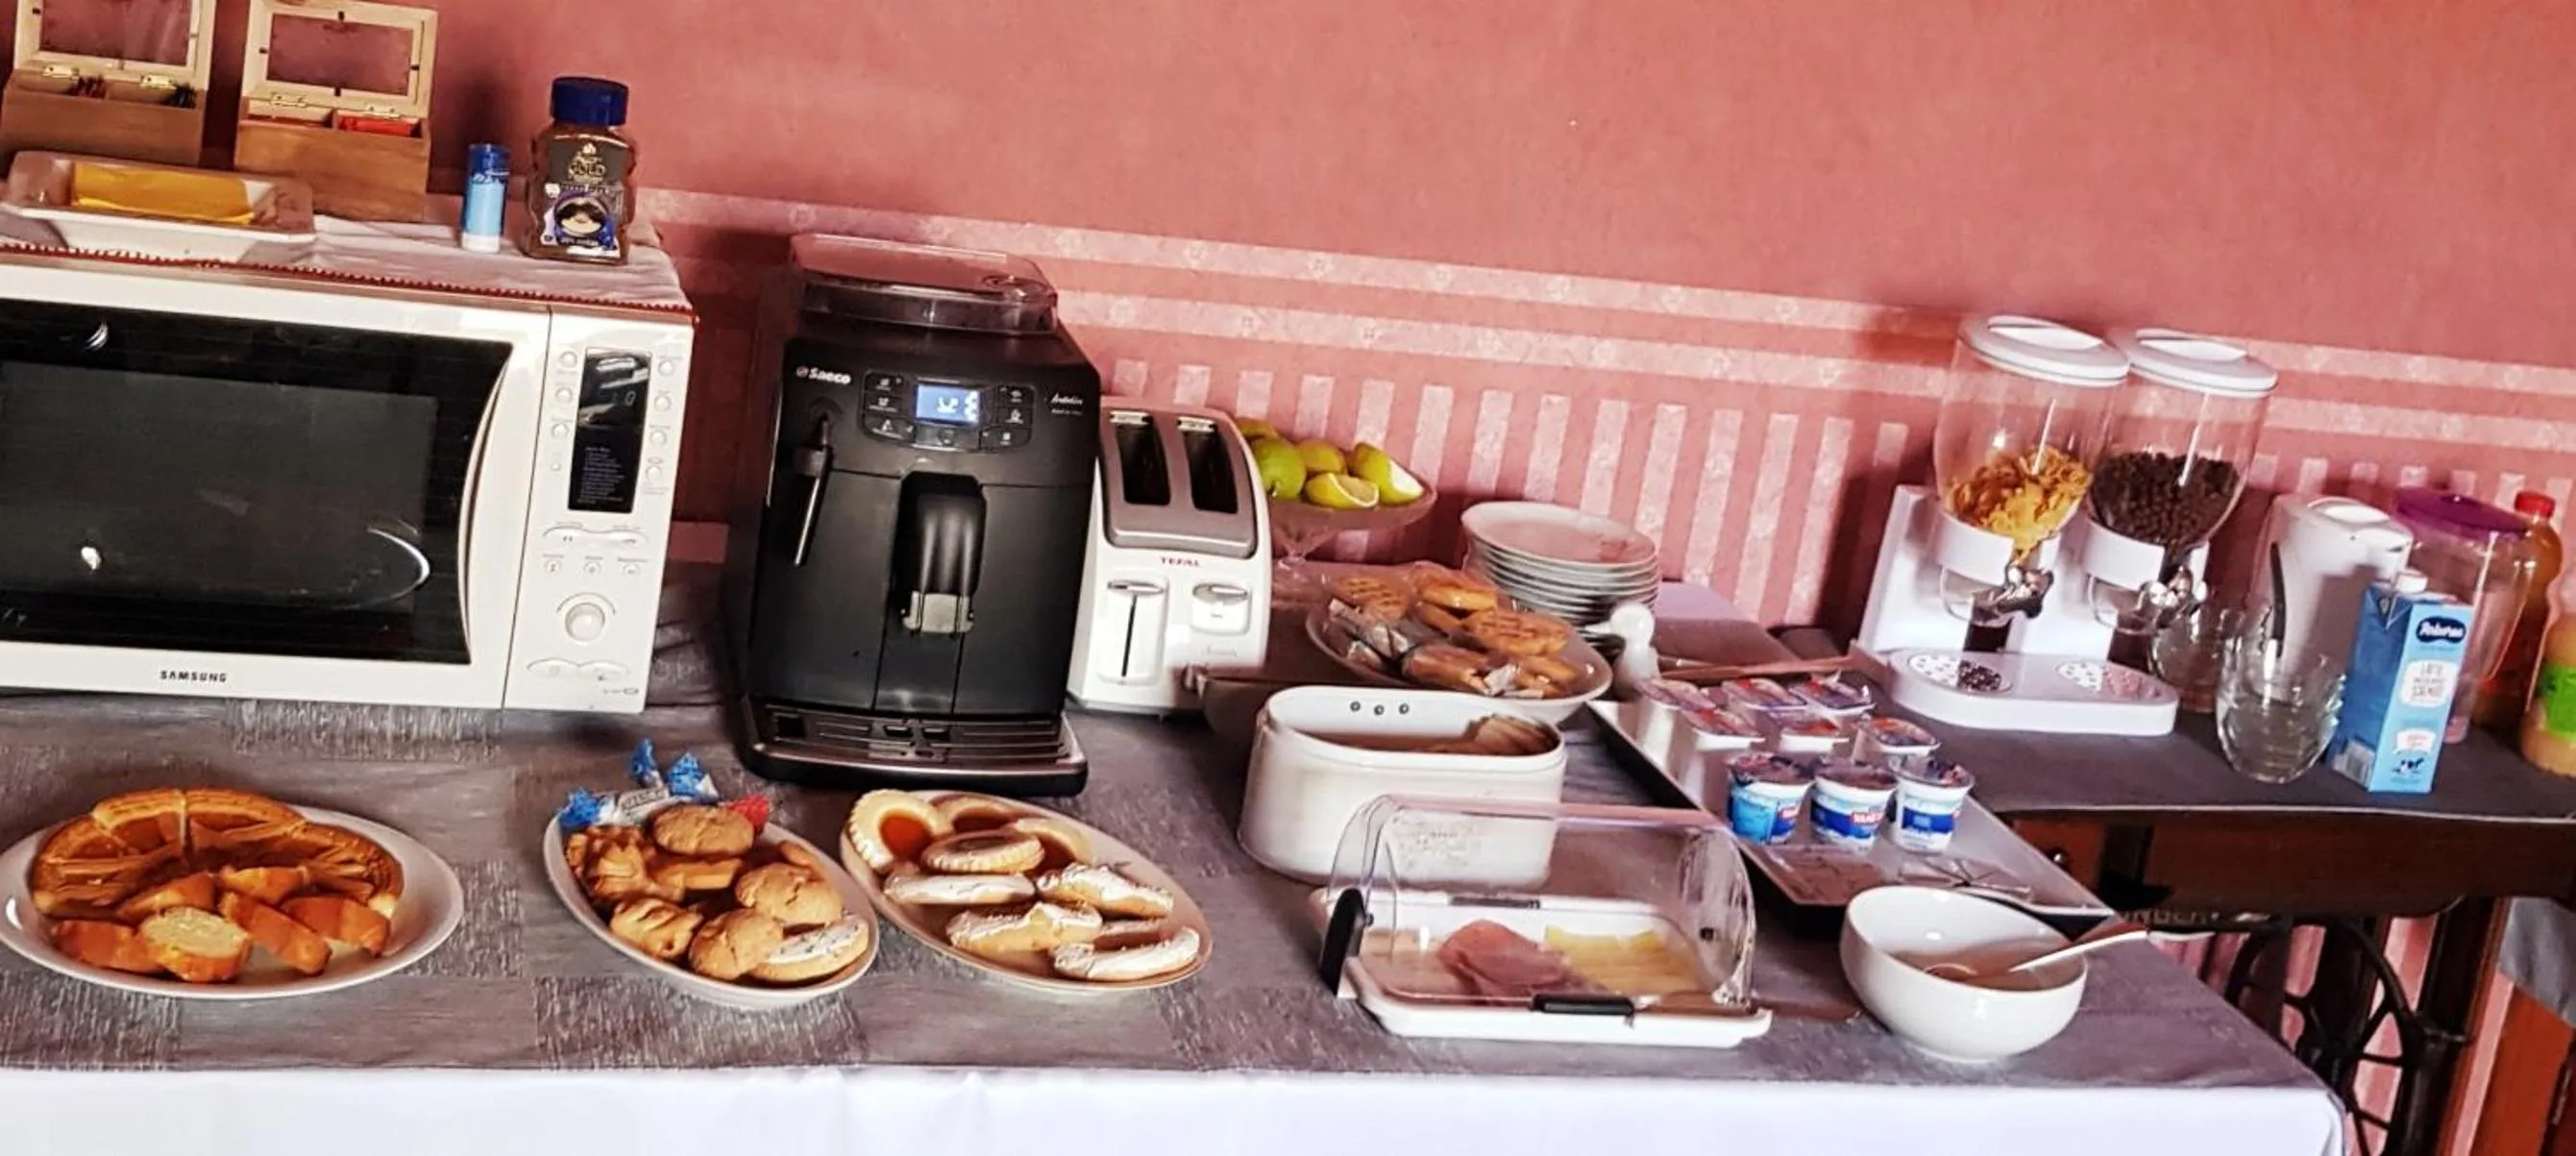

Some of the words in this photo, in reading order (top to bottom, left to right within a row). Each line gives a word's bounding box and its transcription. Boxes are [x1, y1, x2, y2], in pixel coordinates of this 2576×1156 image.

[808, 366, 851, 385] Saeco
[1160, 555, 1203, 568] TEFAL
[159, 670, 228, 683] SAMSUNG
